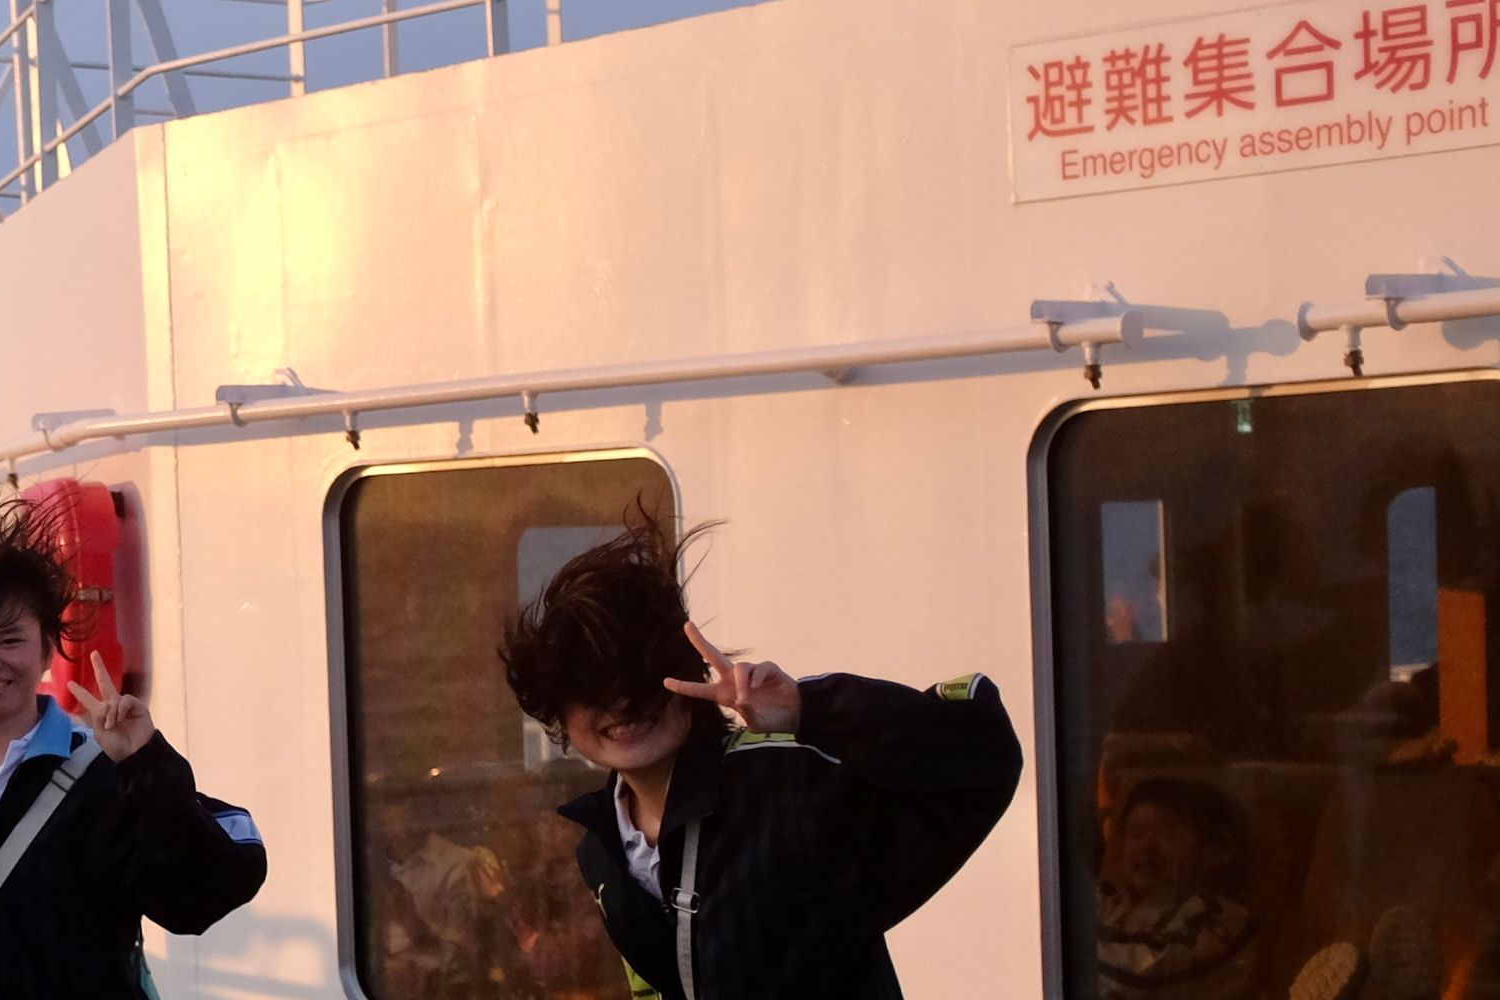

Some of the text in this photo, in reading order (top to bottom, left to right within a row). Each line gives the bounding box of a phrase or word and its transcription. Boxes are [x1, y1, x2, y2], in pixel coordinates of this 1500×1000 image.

[1061, 97, 1489, 181] Emergency assembly point
